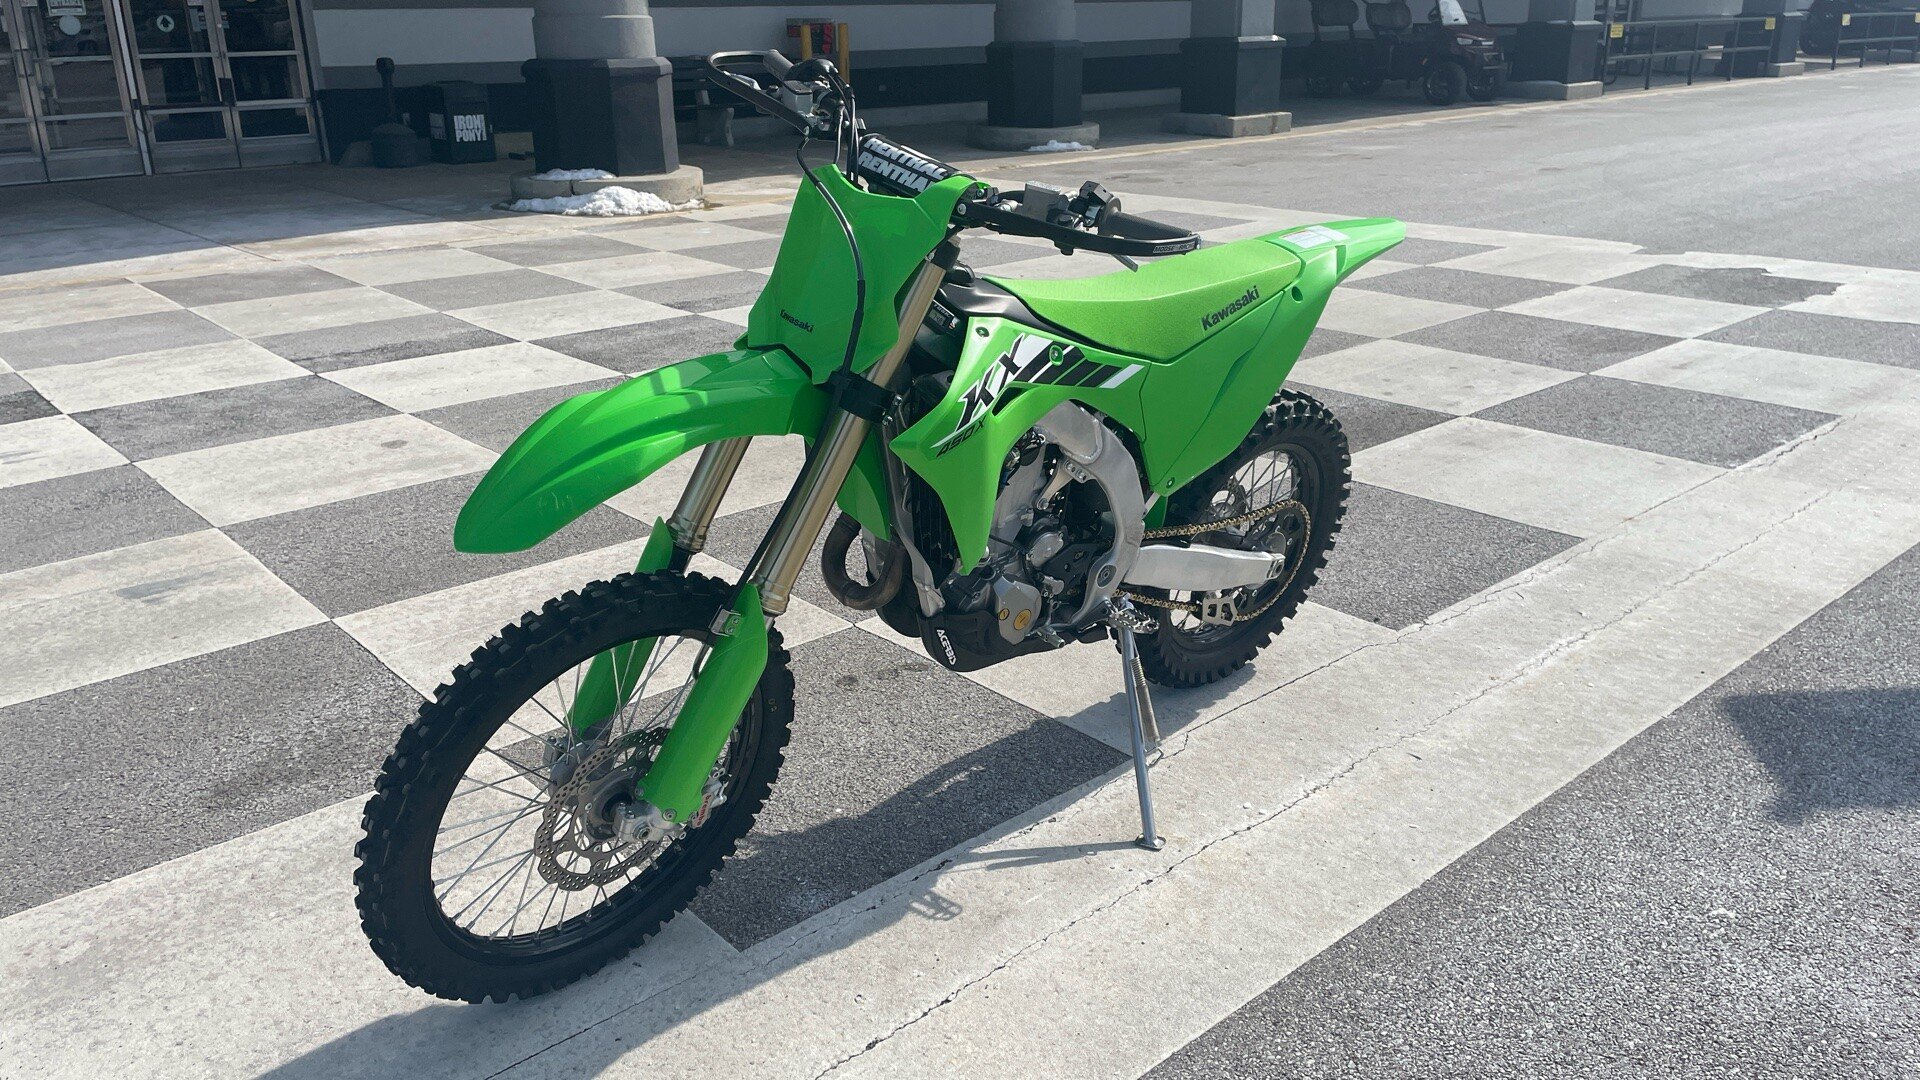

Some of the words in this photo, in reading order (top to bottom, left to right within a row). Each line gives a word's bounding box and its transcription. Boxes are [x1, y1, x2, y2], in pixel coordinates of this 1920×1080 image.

[453, 114, 485, 130] IRON
[455, 129, 482, 142] PONY
[863, 138, 948, 180] RENTHAL
[780, 309, 814, 333] Kawasaki
[1201, 285, 1260, 331] Kawasaki
[955, 334, 1024, 432] KX
